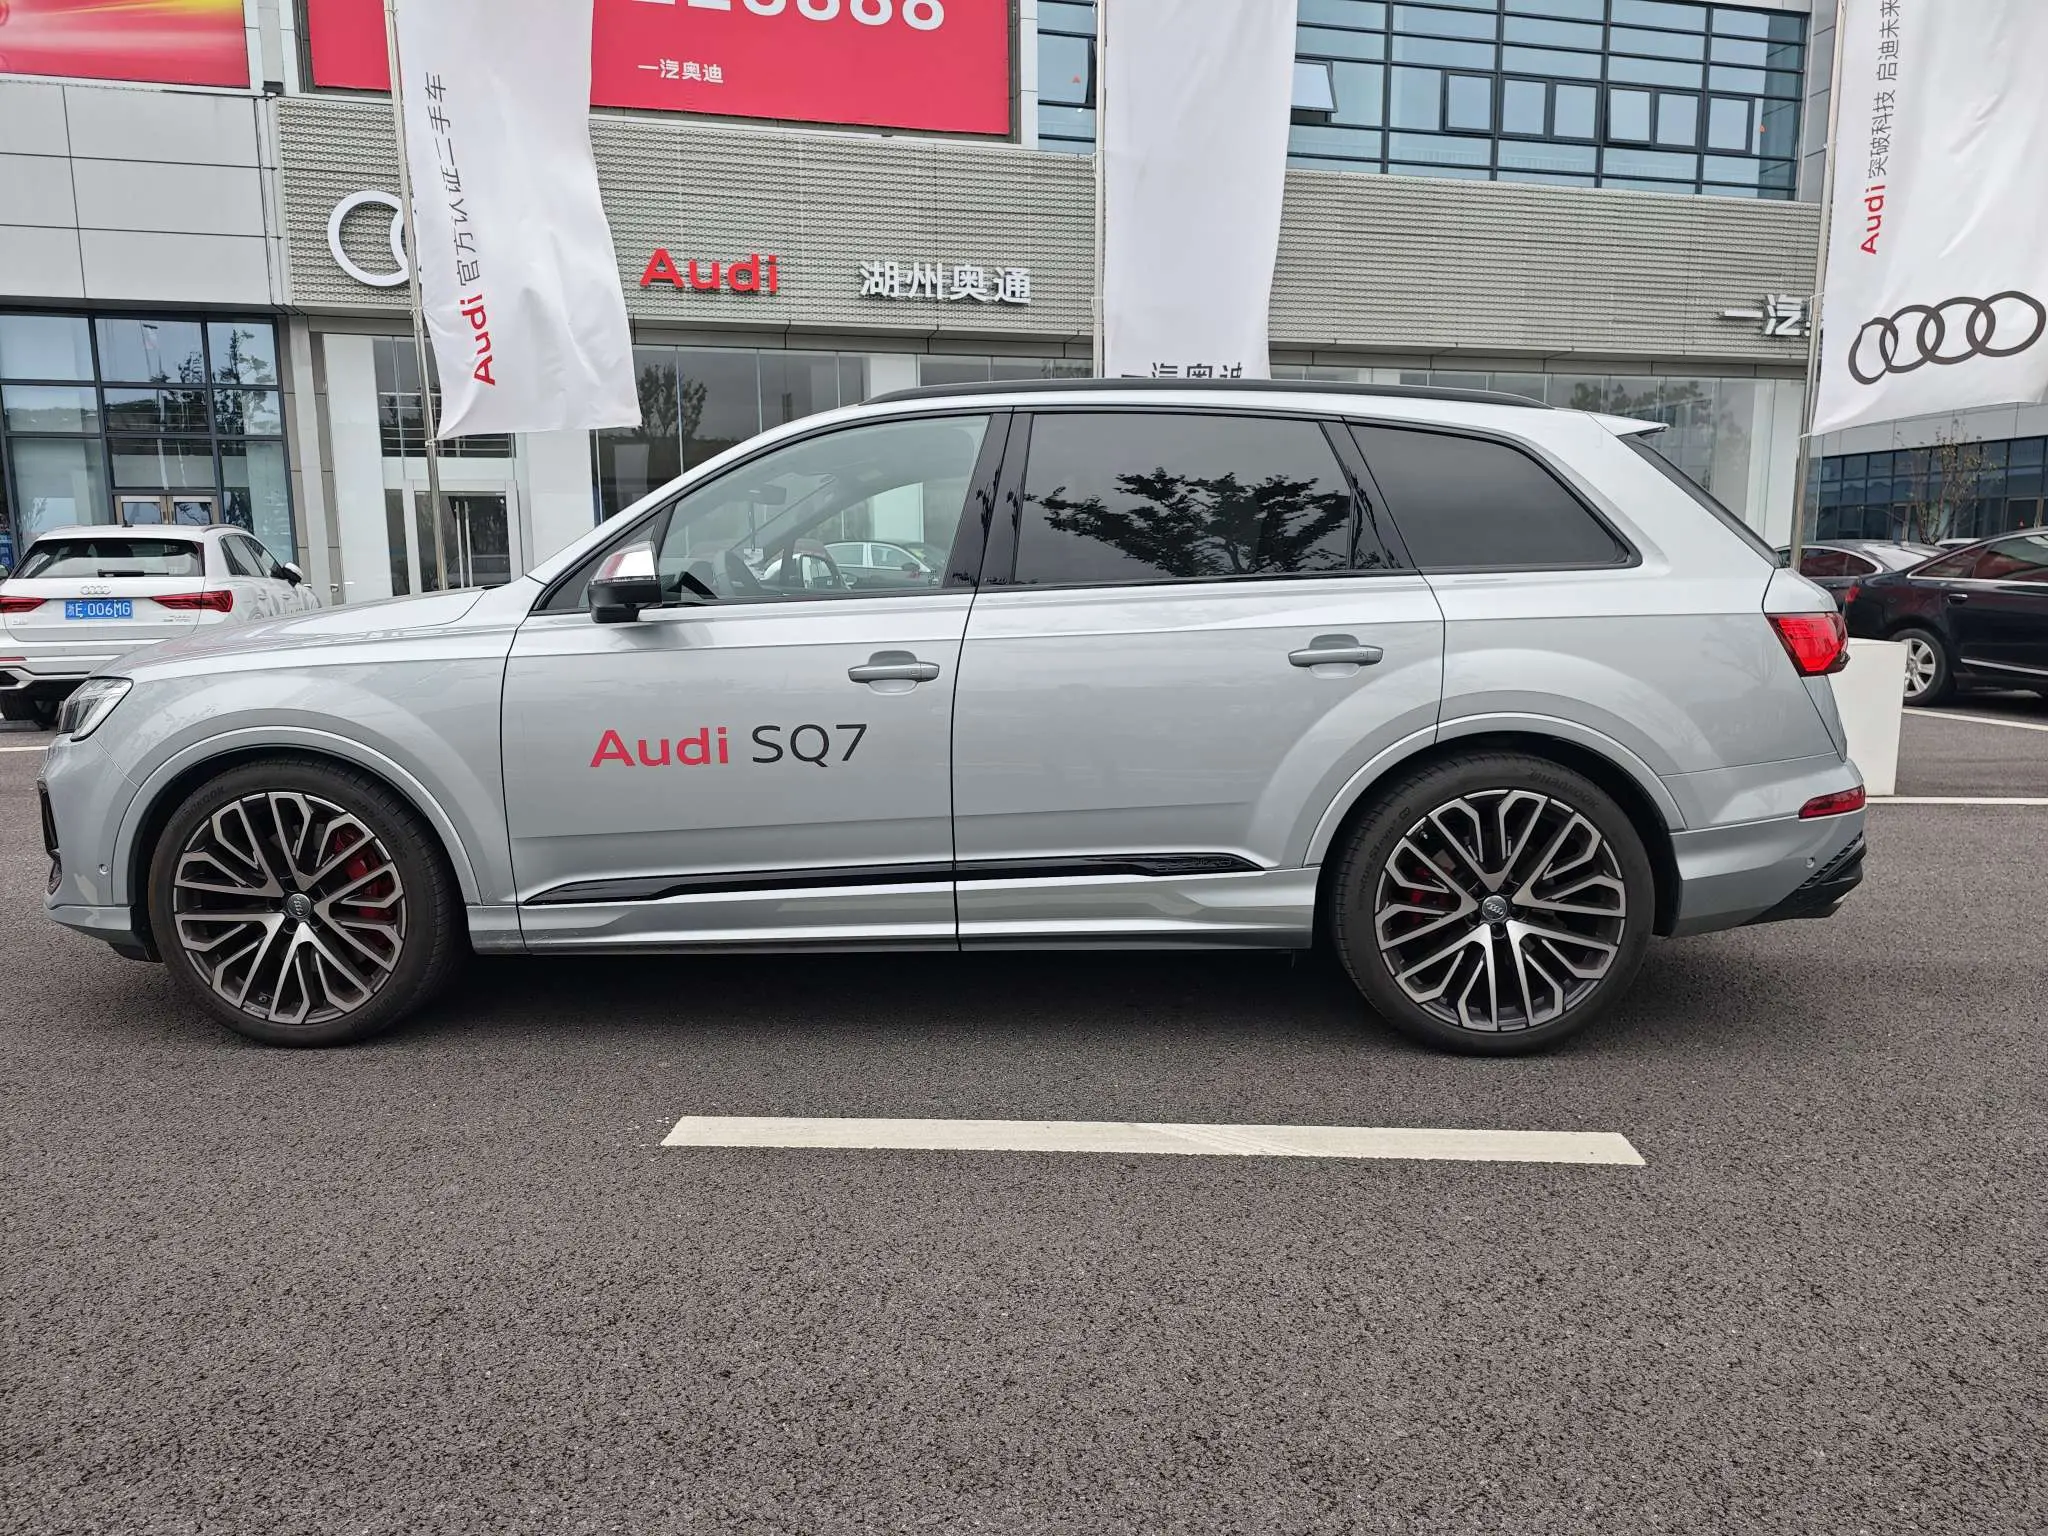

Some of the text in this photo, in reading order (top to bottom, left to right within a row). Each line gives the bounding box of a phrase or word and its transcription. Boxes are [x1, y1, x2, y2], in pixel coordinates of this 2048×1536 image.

[638, 58, 724, 84] 一汽奥迪
[1860, 0, 1901, 254] Audi 突破科技 启迪未来
[425, 72, 496, 386] Audi 官方认证二手车
[640, 248, 778, 294] Audi
[860, 261, 1032, 304] 湖州奥通
[1724, 294, 1810, 337] 一汽
[590, 723, 867, 768] Audi SQ7
